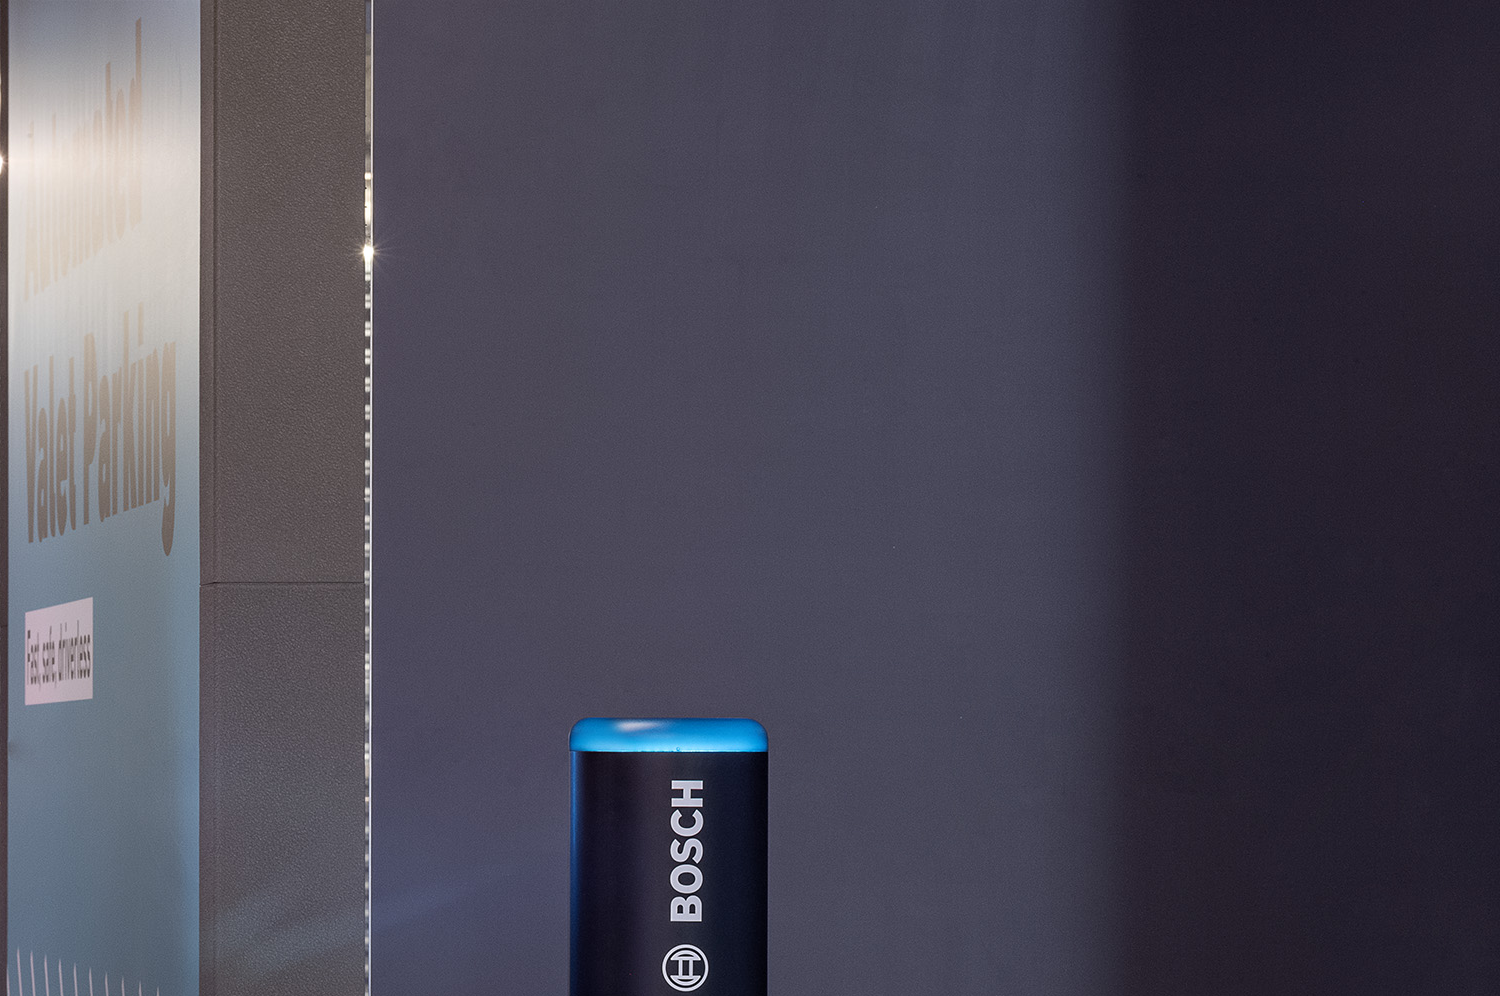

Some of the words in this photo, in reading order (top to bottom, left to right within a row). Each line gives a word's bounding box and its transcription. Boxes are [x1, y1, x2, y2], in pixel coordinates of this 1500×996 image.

[23, 17, 142, 302] Automated
[24, 354, 77, 543] Valet
[83, 301, 177, 557] Parking
[58, 619, 91, 681] driverless
[669, 780, 704, 922] BOSCH
